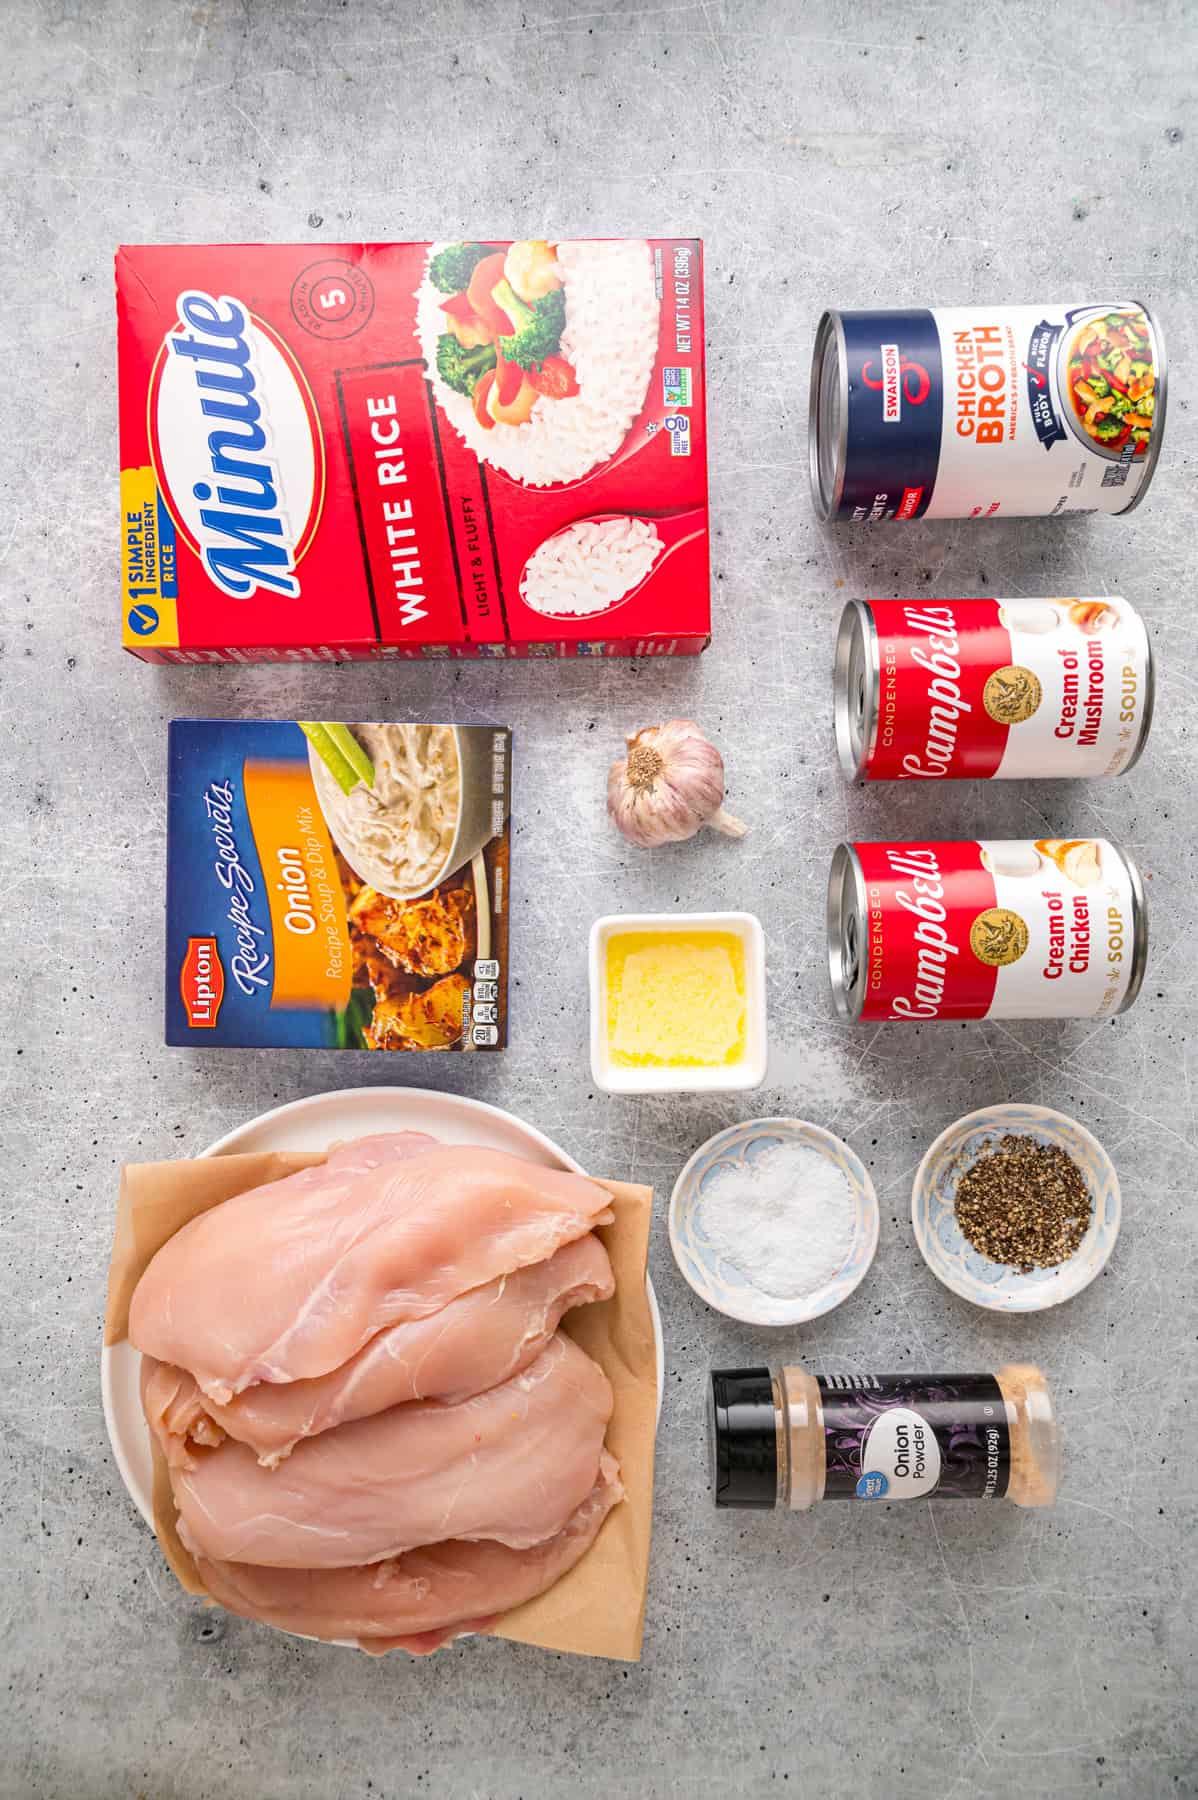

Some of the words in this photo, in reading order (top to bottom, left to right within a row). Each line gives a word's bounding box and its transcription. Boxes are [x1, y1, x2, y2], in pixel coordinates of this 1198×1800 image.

[672, 247, 692, 278] (396g)
[674, 280, 690, 295] OZ
[320, 288, 346, 309] 5
[674, 312, 691, 331] WT
[675, 298, 690, 309] 14
[675, 332, 692, 353] NET
[1037, 332, 1052, 368] FLAVOR
[885, 347, 898, 417] SWANSON
[953, 330, 976, 438] CHICKEN
[973, 325, 1006, 444] BROTH
[1008, 393, 1018, 440] AMERICA'S
[1032, 401, 1042, 423] FULL
[1038, 393, 1053, 427] BODY
[172, 294, 296, 594] Minute
[366, 395, 408, 486] RICE
[127, 511, 144, 583] SIMPLE
[143, 501, 157, 582] INGREDIENT
[461, 496, 480, 552] FLUFFY
[162, 544, 175, 583] RICE
[383, 499, 429, 626] WHITE
[471, 556, 483, 568] &
[129, 588, 157, 600] 1
[472, 571, 491, 617] LIGHT
[1057, 649, 1078, 670] of
[882, 644, 897, 746] CONDENSED
[898, 606, 972, 779] Campbell's
[1055, 673, 1079, 739] Cream
[1077, 640, 1105, 747] Mushroom
[1119, 665, 1138, 722] SOUP
[203, 779, 255, 892] Secrets
[296, 805, 317, 835] Mix
[304, 837, 326, 864] Dip
[310, 866, 327, 880] &
[276, 848, 316, 935] Onion
[316, 884, 336, 923] Soup
[1041, 891, 1062, 911] of
[226, 894, 270, 996] Recipe
[325, 925, 345, 980] Recipe
[869, 888, 884, 990] CONDENSED
[886, 849, 960, 1021] Campbell's
[1043, 913, 1065, 980] Cream
[1068, 895, 1092, 974] Chicken
[1107, 907, 1124, 962] SOUP
[191, 944, 218, 1020] Lipton
[475, 1029, 486, 1041] 20
[893, 1424, 909, 1478] Onion
[912, 1423, 926, 1479] Powder
[985, 1429, 1000, 1455] (92g)
[987, 1455, 999, 1468] OZ
